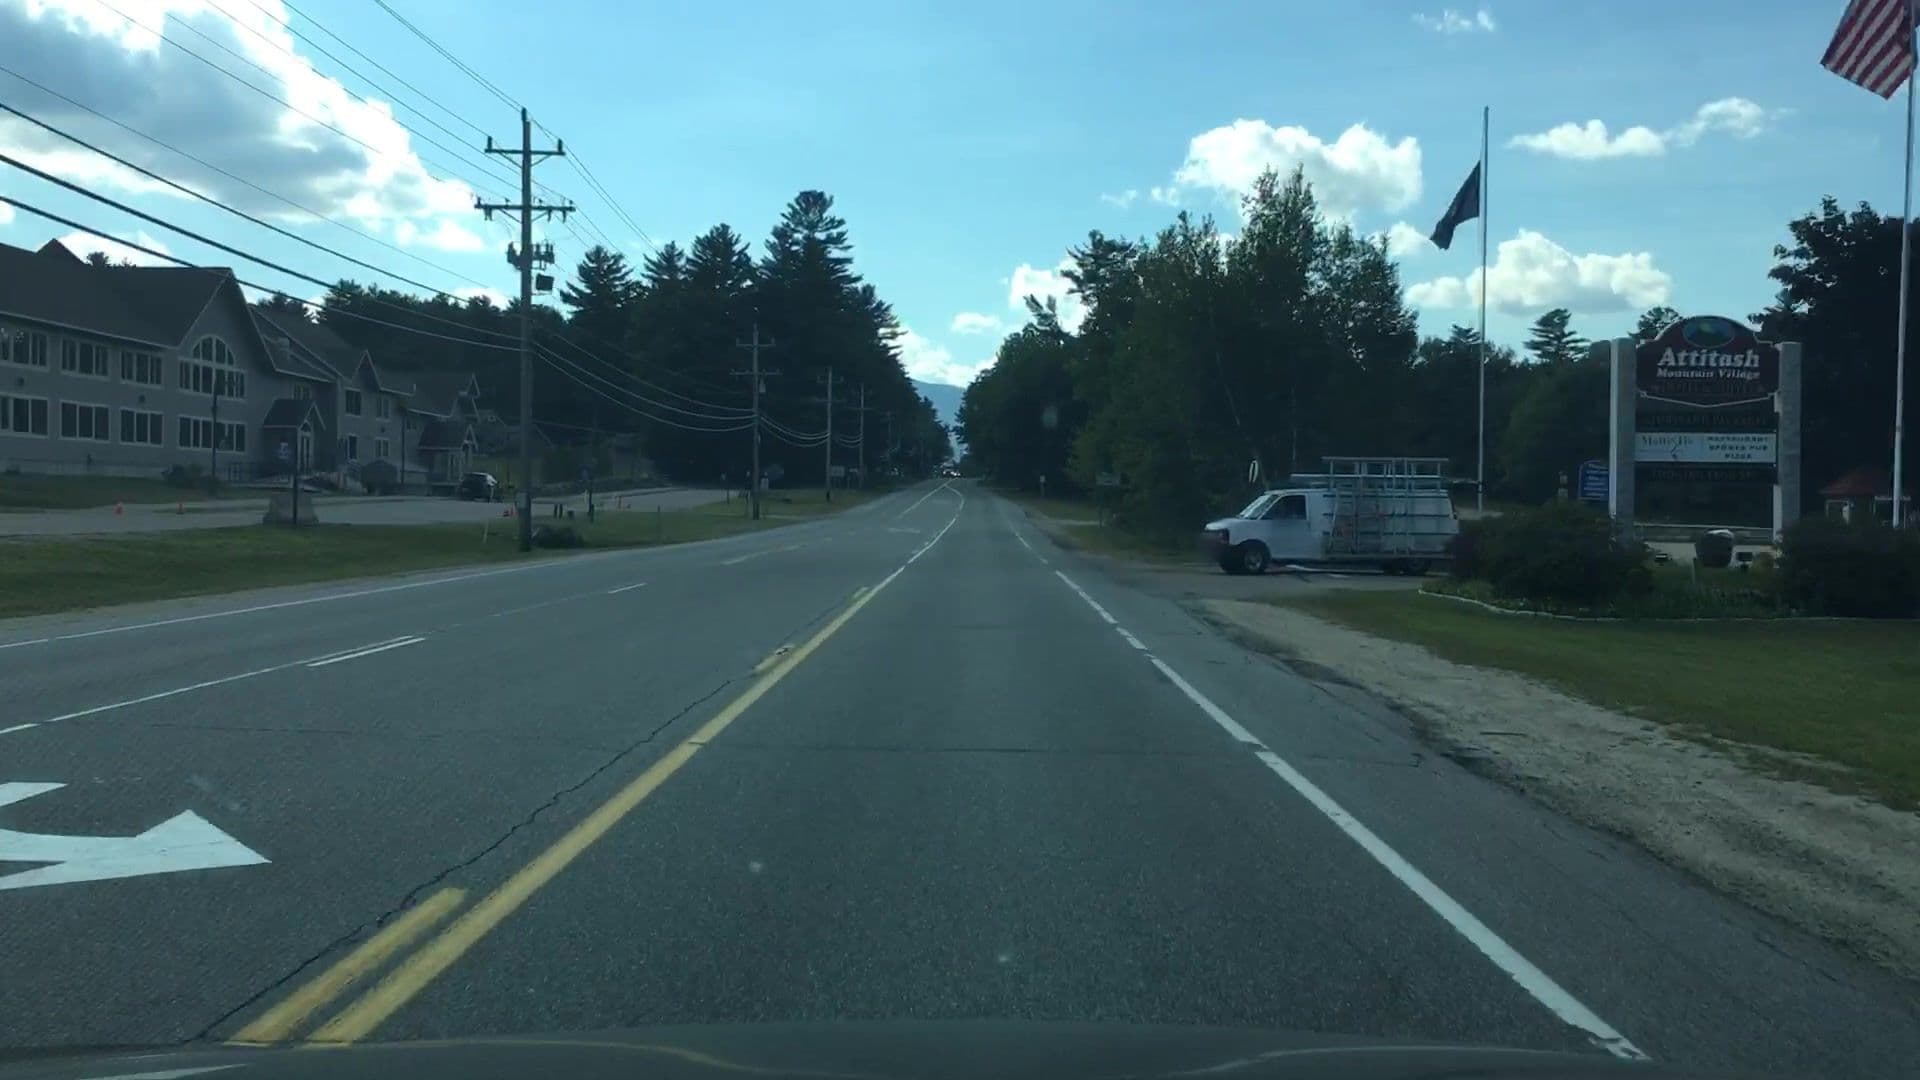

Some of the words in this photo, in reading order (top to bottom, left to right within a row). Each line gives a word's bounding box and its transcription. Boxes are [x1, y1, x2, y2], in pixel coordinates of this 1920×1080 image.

[1657, 347, 1760, 367] Attitash
[1656, 368, 1714, 378] Mountain
[1719, 368, 1760, 380] Village
